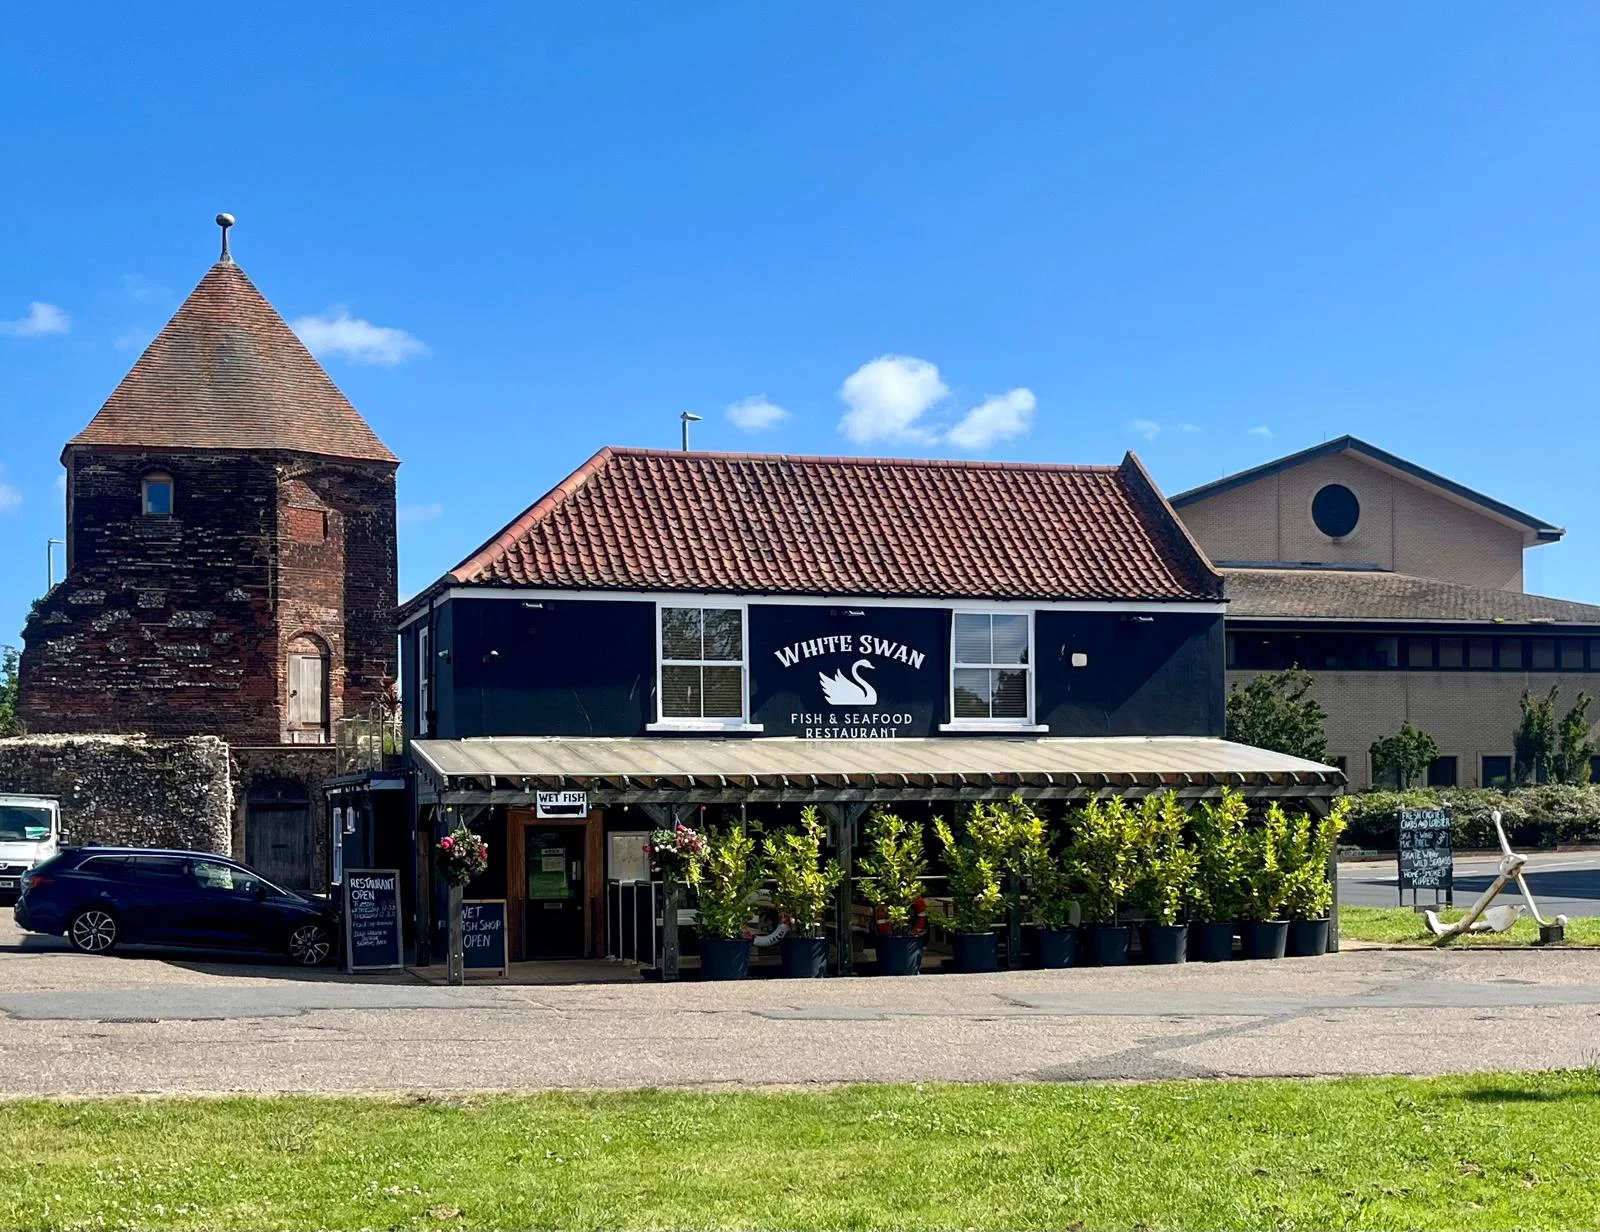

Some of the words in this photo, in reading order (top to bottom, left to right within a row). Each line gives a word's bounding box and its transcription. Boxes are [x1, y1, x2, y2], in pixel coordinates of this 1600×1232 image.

[774, 635, 852, 668] WHITE
[859, 635, 926, 669] SWAN
[791, 713, 822, 724] FISH
[829, 713, 838, 724] &
[845, 713, 912, 724] SEAFOOD
[806, 728, 897, 738] RESTAURANT
[539, 793, 559, 802] WET
[563, 793, 585, 802] FISH
[1402, 811, 1421, 820] FRESH
[350, 878, 395, 890] RESTAURANT
[1412, 877, 1440, 886] KIPPERS
[352, 890, 375, 900] OPEN
[479, 920, 501, 931] SHOP
[464, 934, 491, 948] OPEN
